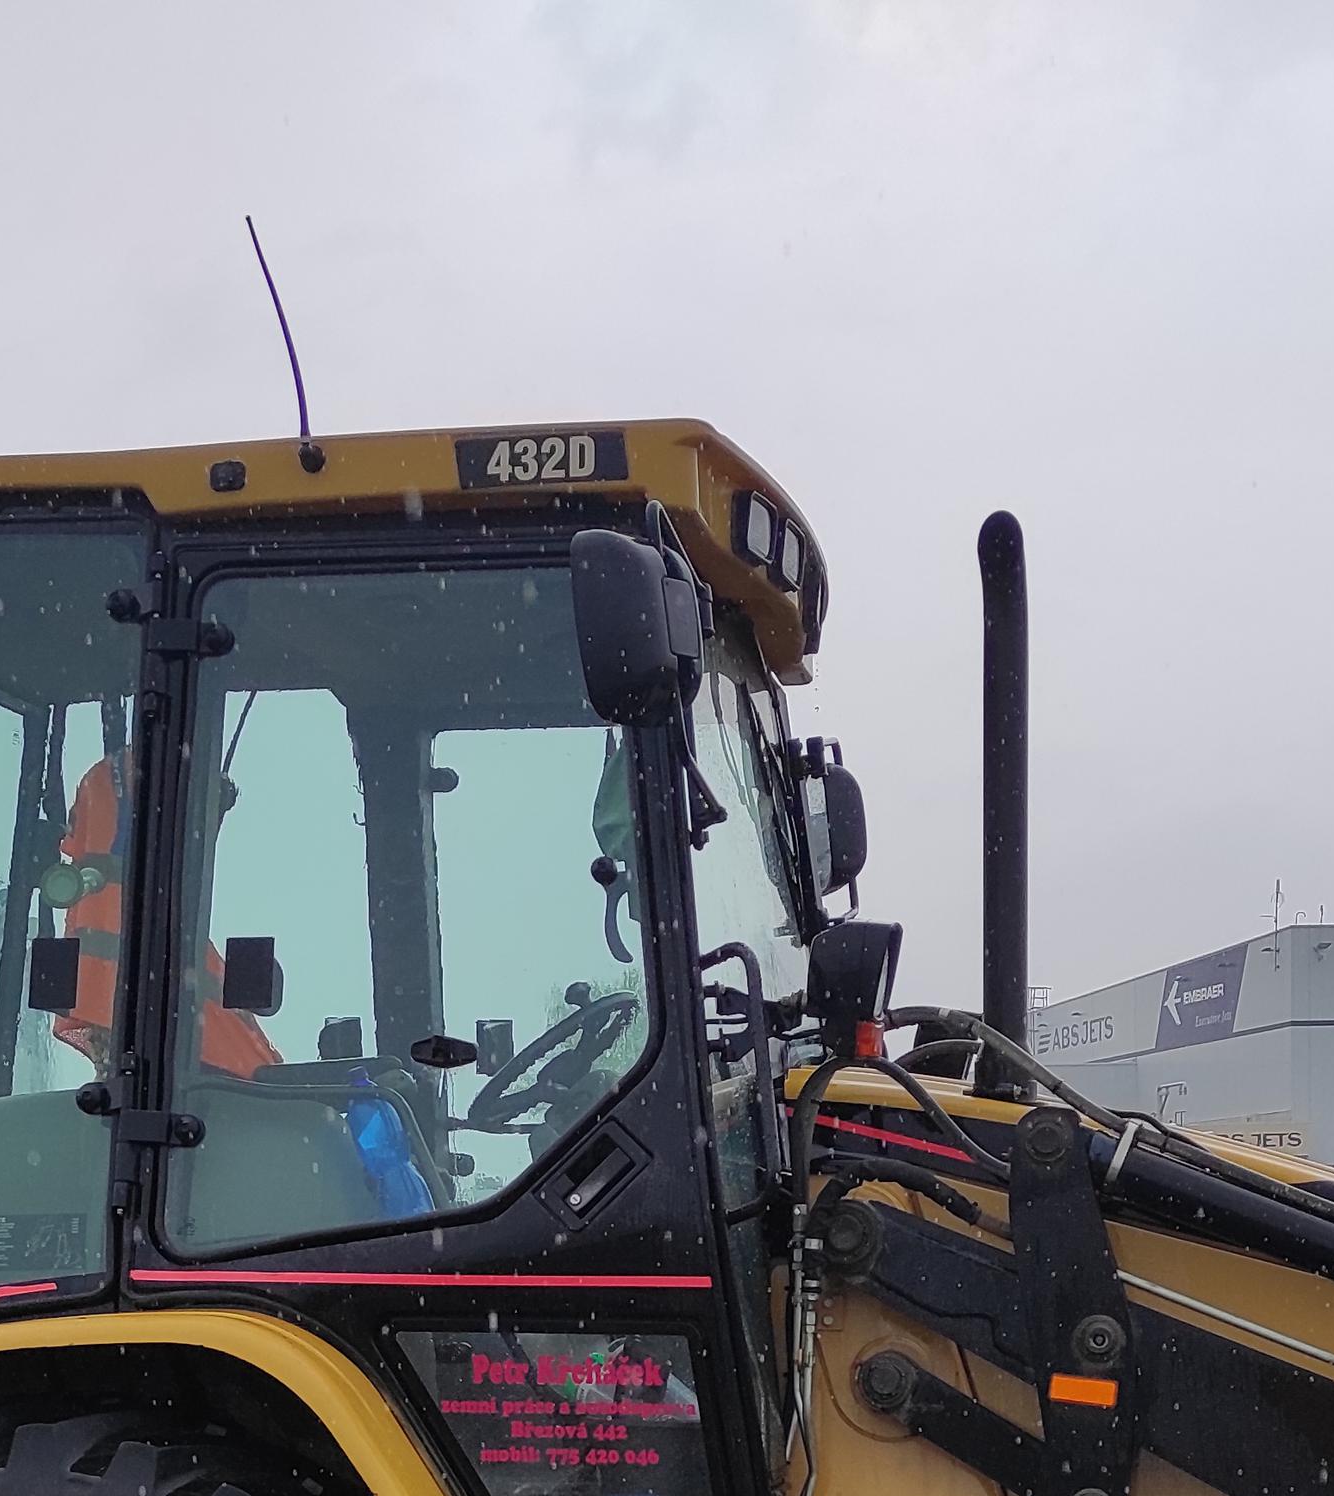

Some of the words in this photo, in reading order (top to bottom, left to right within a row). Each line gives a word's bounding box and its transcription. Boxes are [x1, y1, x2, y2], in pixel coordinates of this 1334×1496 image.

[486, 435, 596, 482] 432D
[1183, 984, 1224, 1005] EMBRAER
[1052, 1023, 1079, 1051] ABS
[1081, 1015, 1114, 1045] JETS
[1251, 1132, 1302, 1147] JETS
[471, 1353, 529, 1385] Petr
[559, 1401, 571, 1415] a
[593, 1424, 628, 1441] 442
[585, 1449, 620, 1465] 420
